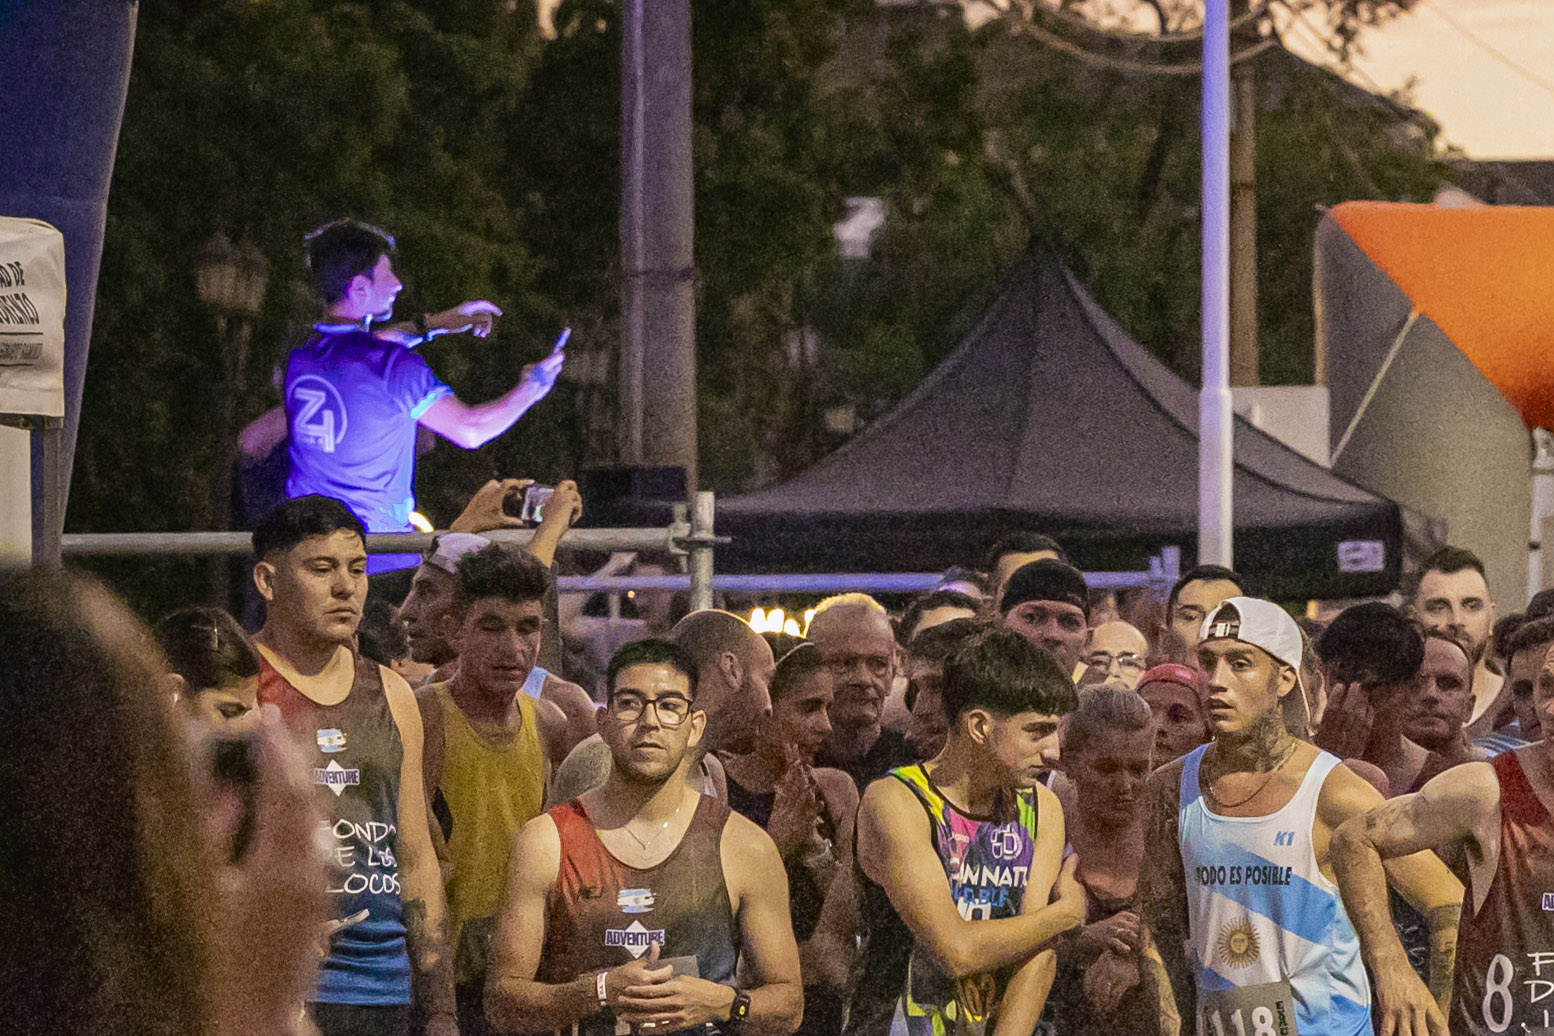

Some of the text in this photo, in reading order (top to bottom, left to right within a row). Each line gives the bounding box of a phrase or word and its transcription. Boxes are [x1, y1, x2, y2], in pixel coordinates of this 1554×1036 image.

[1229, 866, 1241, 885] ES
[1245, 866, 1293, 886] POSIBLE
[606, 930, 664, 946] ADVENTURE
[1482, 953, 1514, 1033] 8
